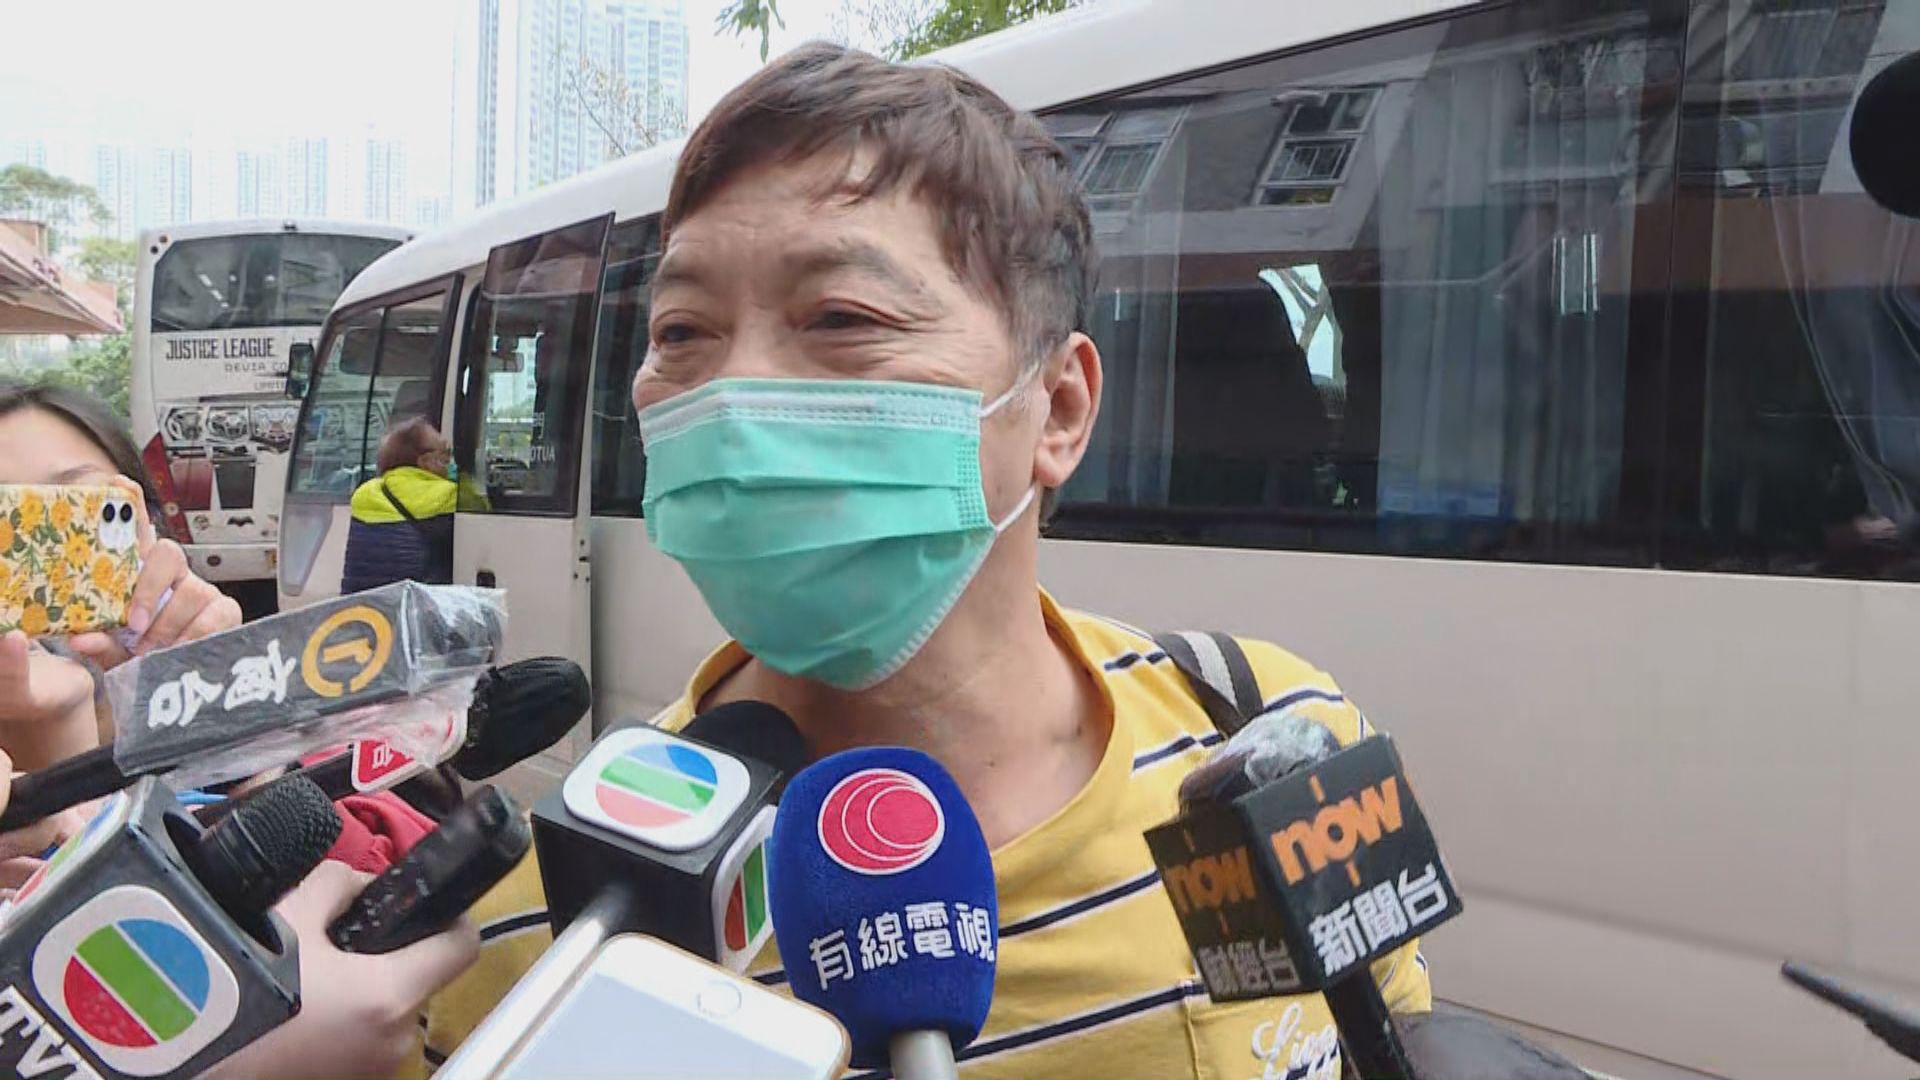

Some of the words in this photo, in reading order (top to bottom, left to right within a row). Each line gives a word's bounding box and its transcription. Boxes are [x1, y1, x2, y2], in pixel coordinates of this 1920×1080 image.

[166, 339, 219, 360] JUSTICE
[223, 337, 276, 359] LEAGUE
[1270, 775, 1403, 887] now
[1165, 845, 1258, 916] now
[1308, 862, 1449, 978] 新聞台
[809, 901, 997, 991] 有線電視
